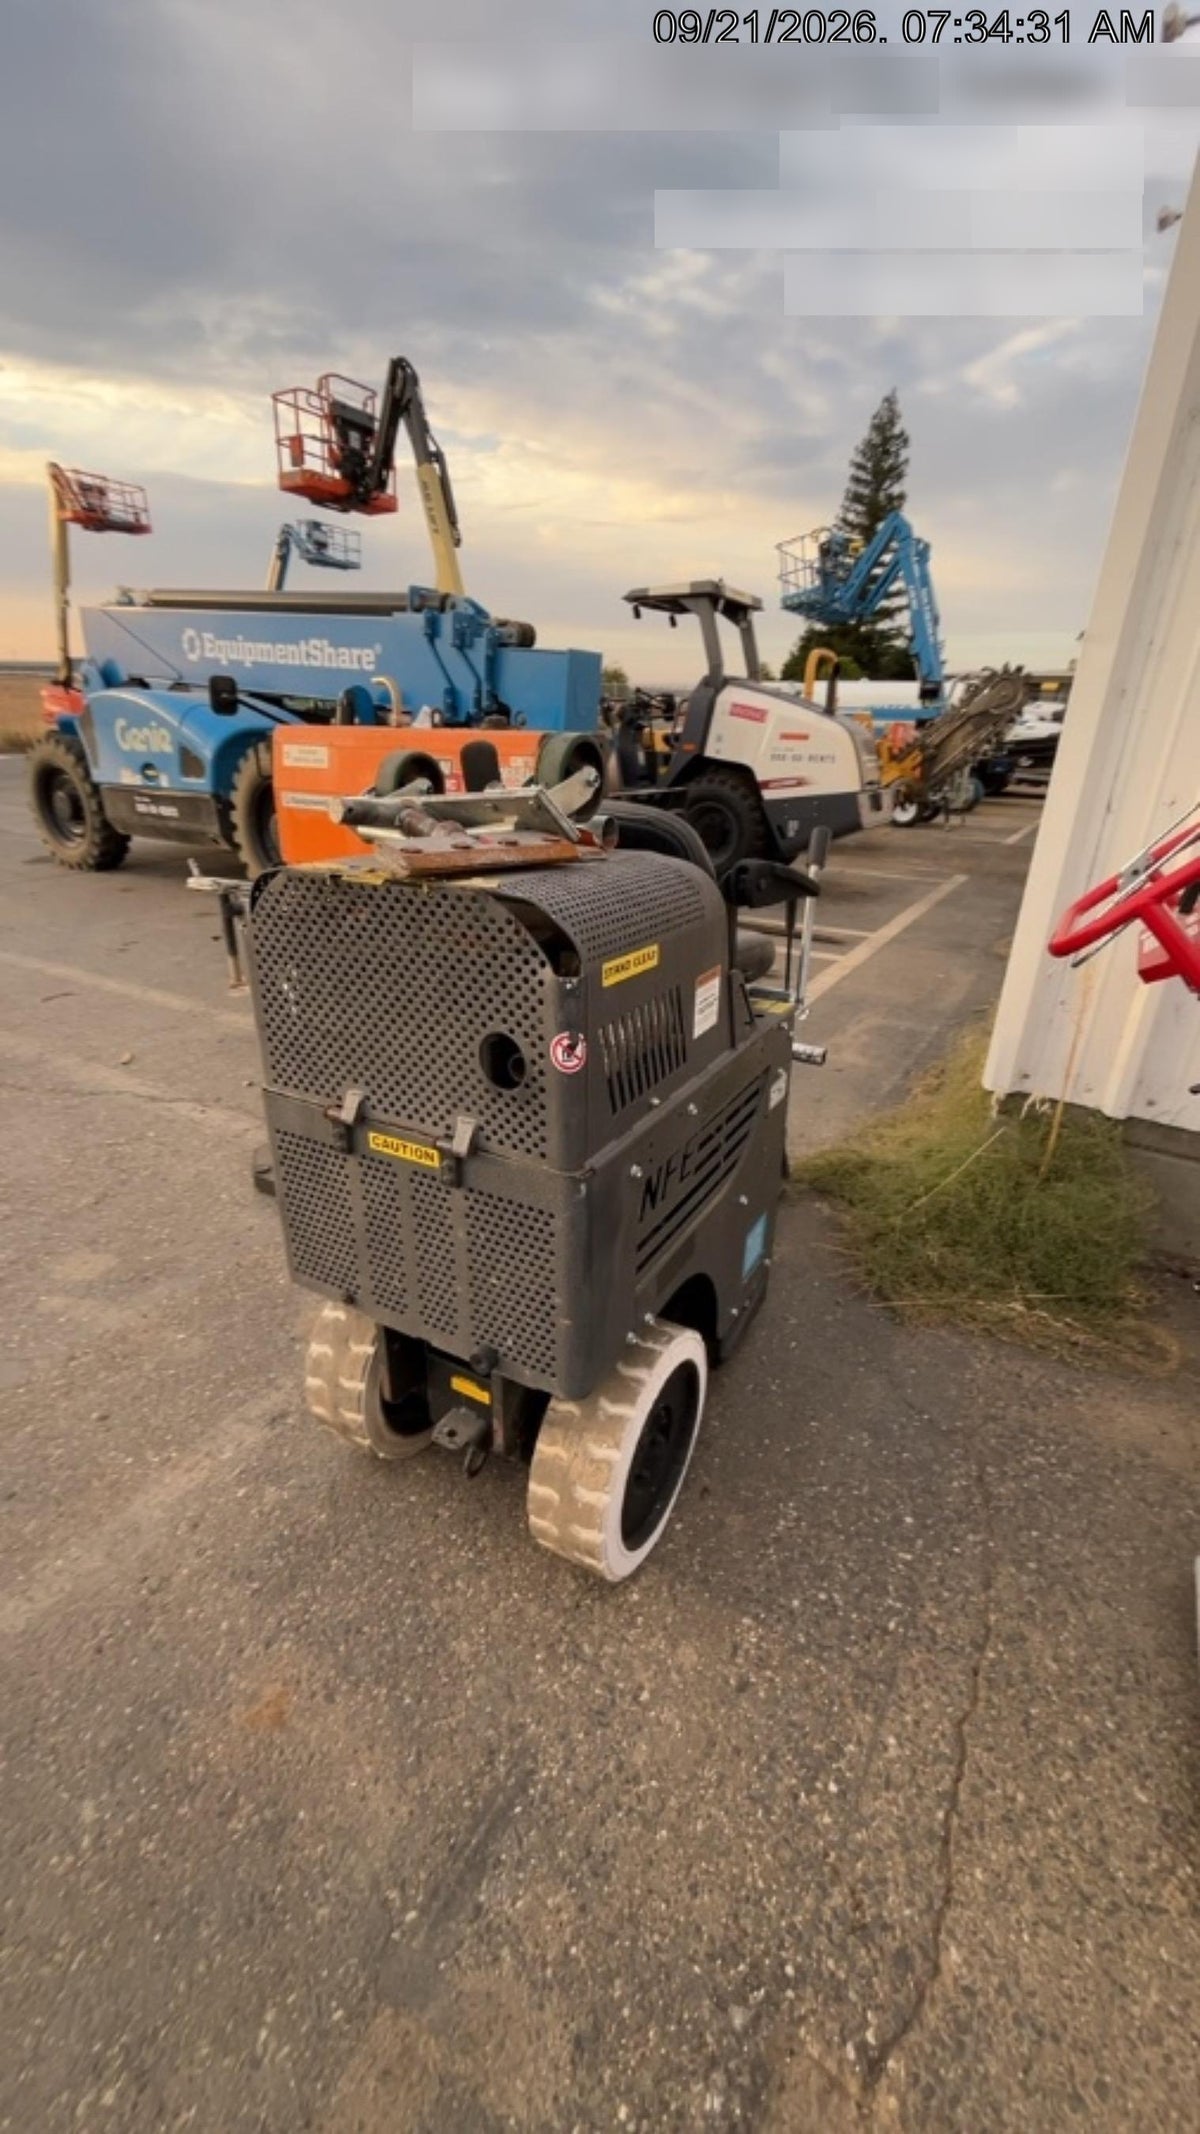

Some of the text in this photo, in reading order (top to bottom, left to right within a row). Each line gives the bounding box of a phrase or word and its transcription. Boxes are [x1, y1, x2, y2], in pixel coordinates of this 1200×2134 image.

[202, 632, 376, 671] EquipmentShare
[115, 718, 173, 753] Genie
[371, 1135, 436, 1163] CAUTION
